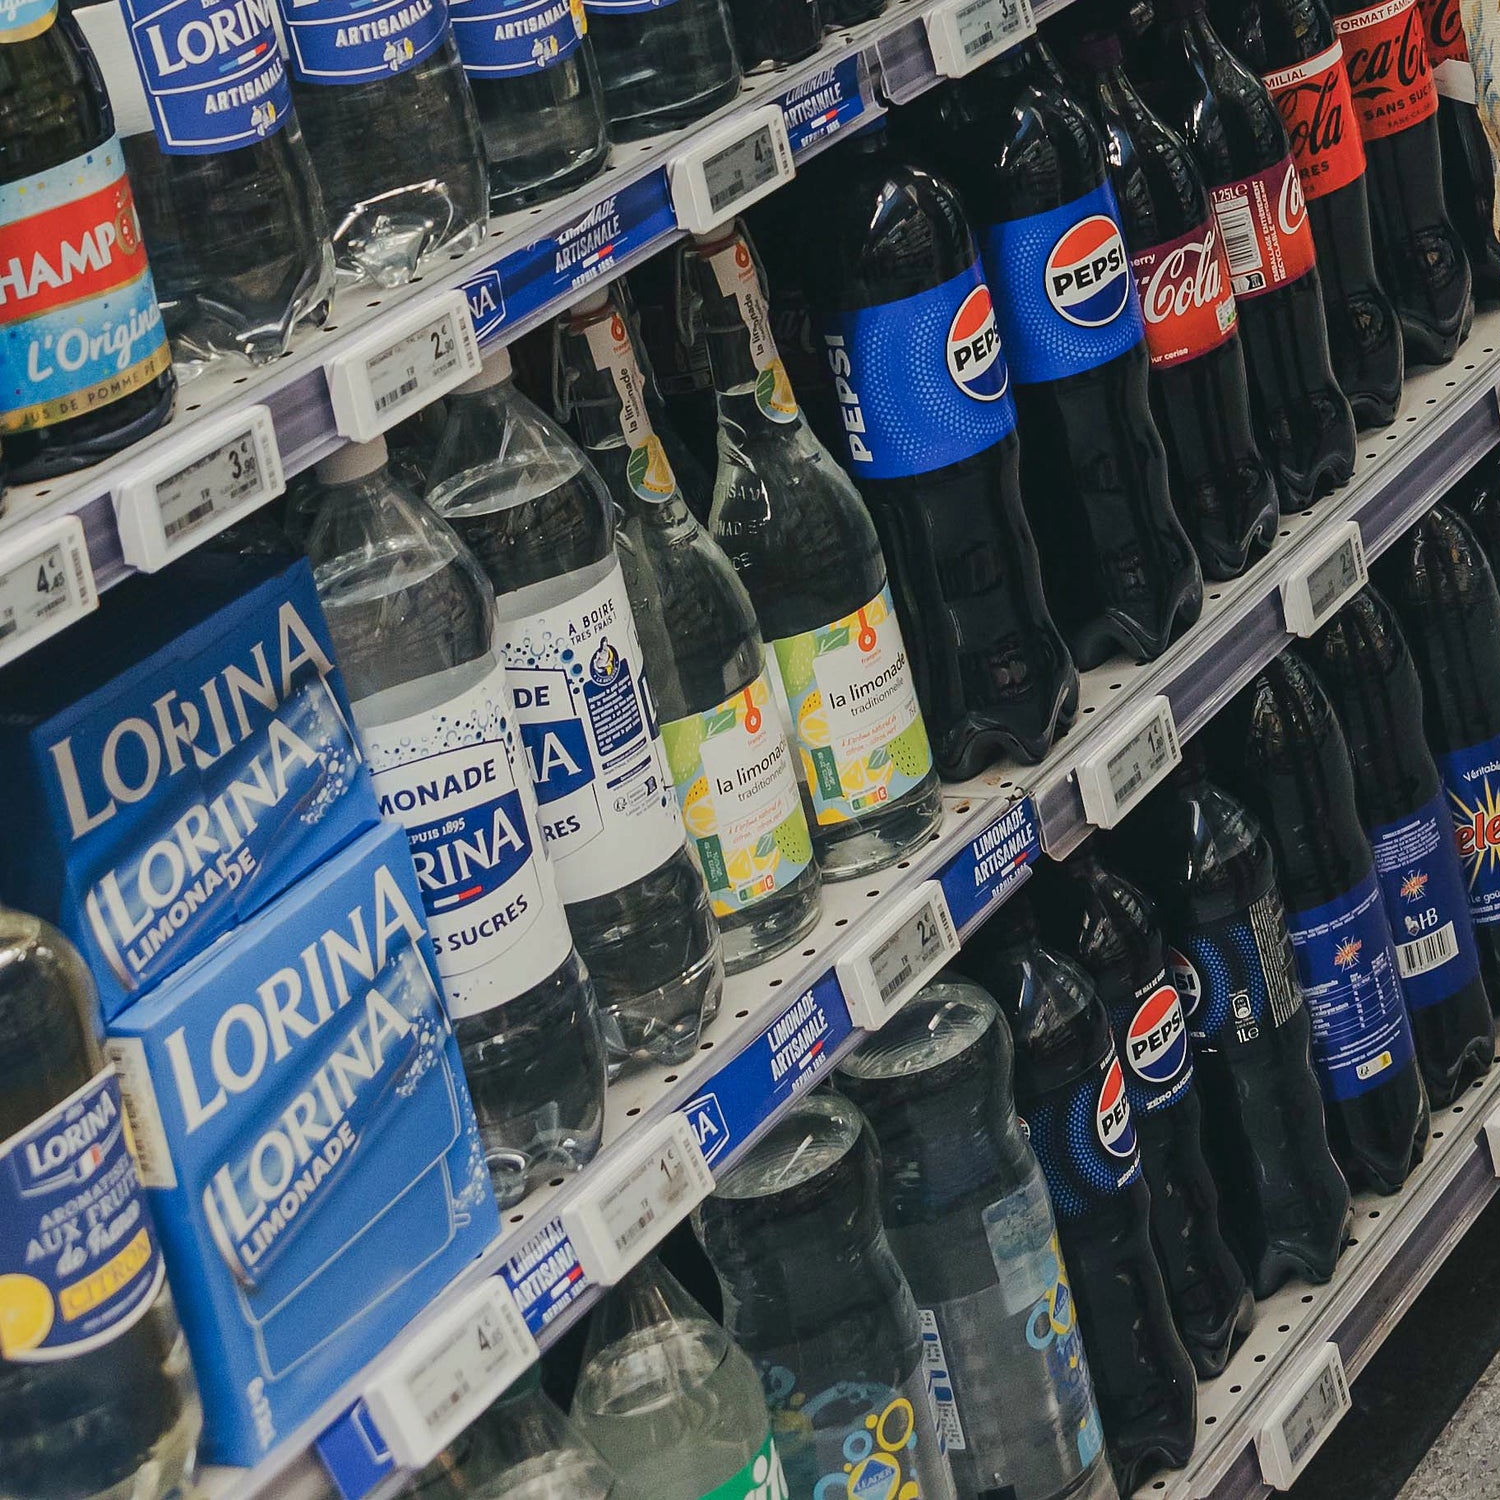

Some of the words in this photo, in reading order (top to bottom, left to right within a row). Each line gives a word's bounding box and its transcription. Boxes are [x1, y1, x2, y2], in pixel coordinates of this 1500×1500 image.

[204, 56, 285, 115] ARTISANALE
[784, 83, 843, 129] ARTISANALE
[1264, 68, 1308, 90] MILIAL
[1363, 98, 1406, 123] SANS
[555, 214, 622, 274] ARTISANALE
[1051, 244, 1125, 298] PEPSI
[27, 302, 162, 384] L'Origina
[87, 373, 138, 405] POMME
[824, 334, 874, 463] PEPSI
[583, 598, 615, 628] BOIRE
[830, 691, 847, 711] la
[849, 650, 906, 702] limonade
[850, 676, 905, 718] traditionnelle
[48, 600, 336, 843] LORINA
[377, 757, 498, 815] MONADE
[716, 778, 735, 796] la
[99, 717, 320, 947] LORINA
[414, 806, 525, 892] RINA
[973, 805, 1027, 861] LIMONADE
[974, 822, 1035, 888] ARTISANALE
[126, 847, 258, 975] LIMONADE
[449, 893, 529, 953] SUCRES
[1418, 906, 1439, 930] HB
[163, 863, 428, 1136] LORINA
[767, 989, 818, 1053] LIMONADE
[770, 1007, 829, 1083] ARTISANALE
[25, 1088, 118, 1178] LORINA
[215, 987, 415, 1243] LORINA
[239, 1119, 358, 1267] LIMONADE
[511, 1241, 577, 1313] ARTISANA
